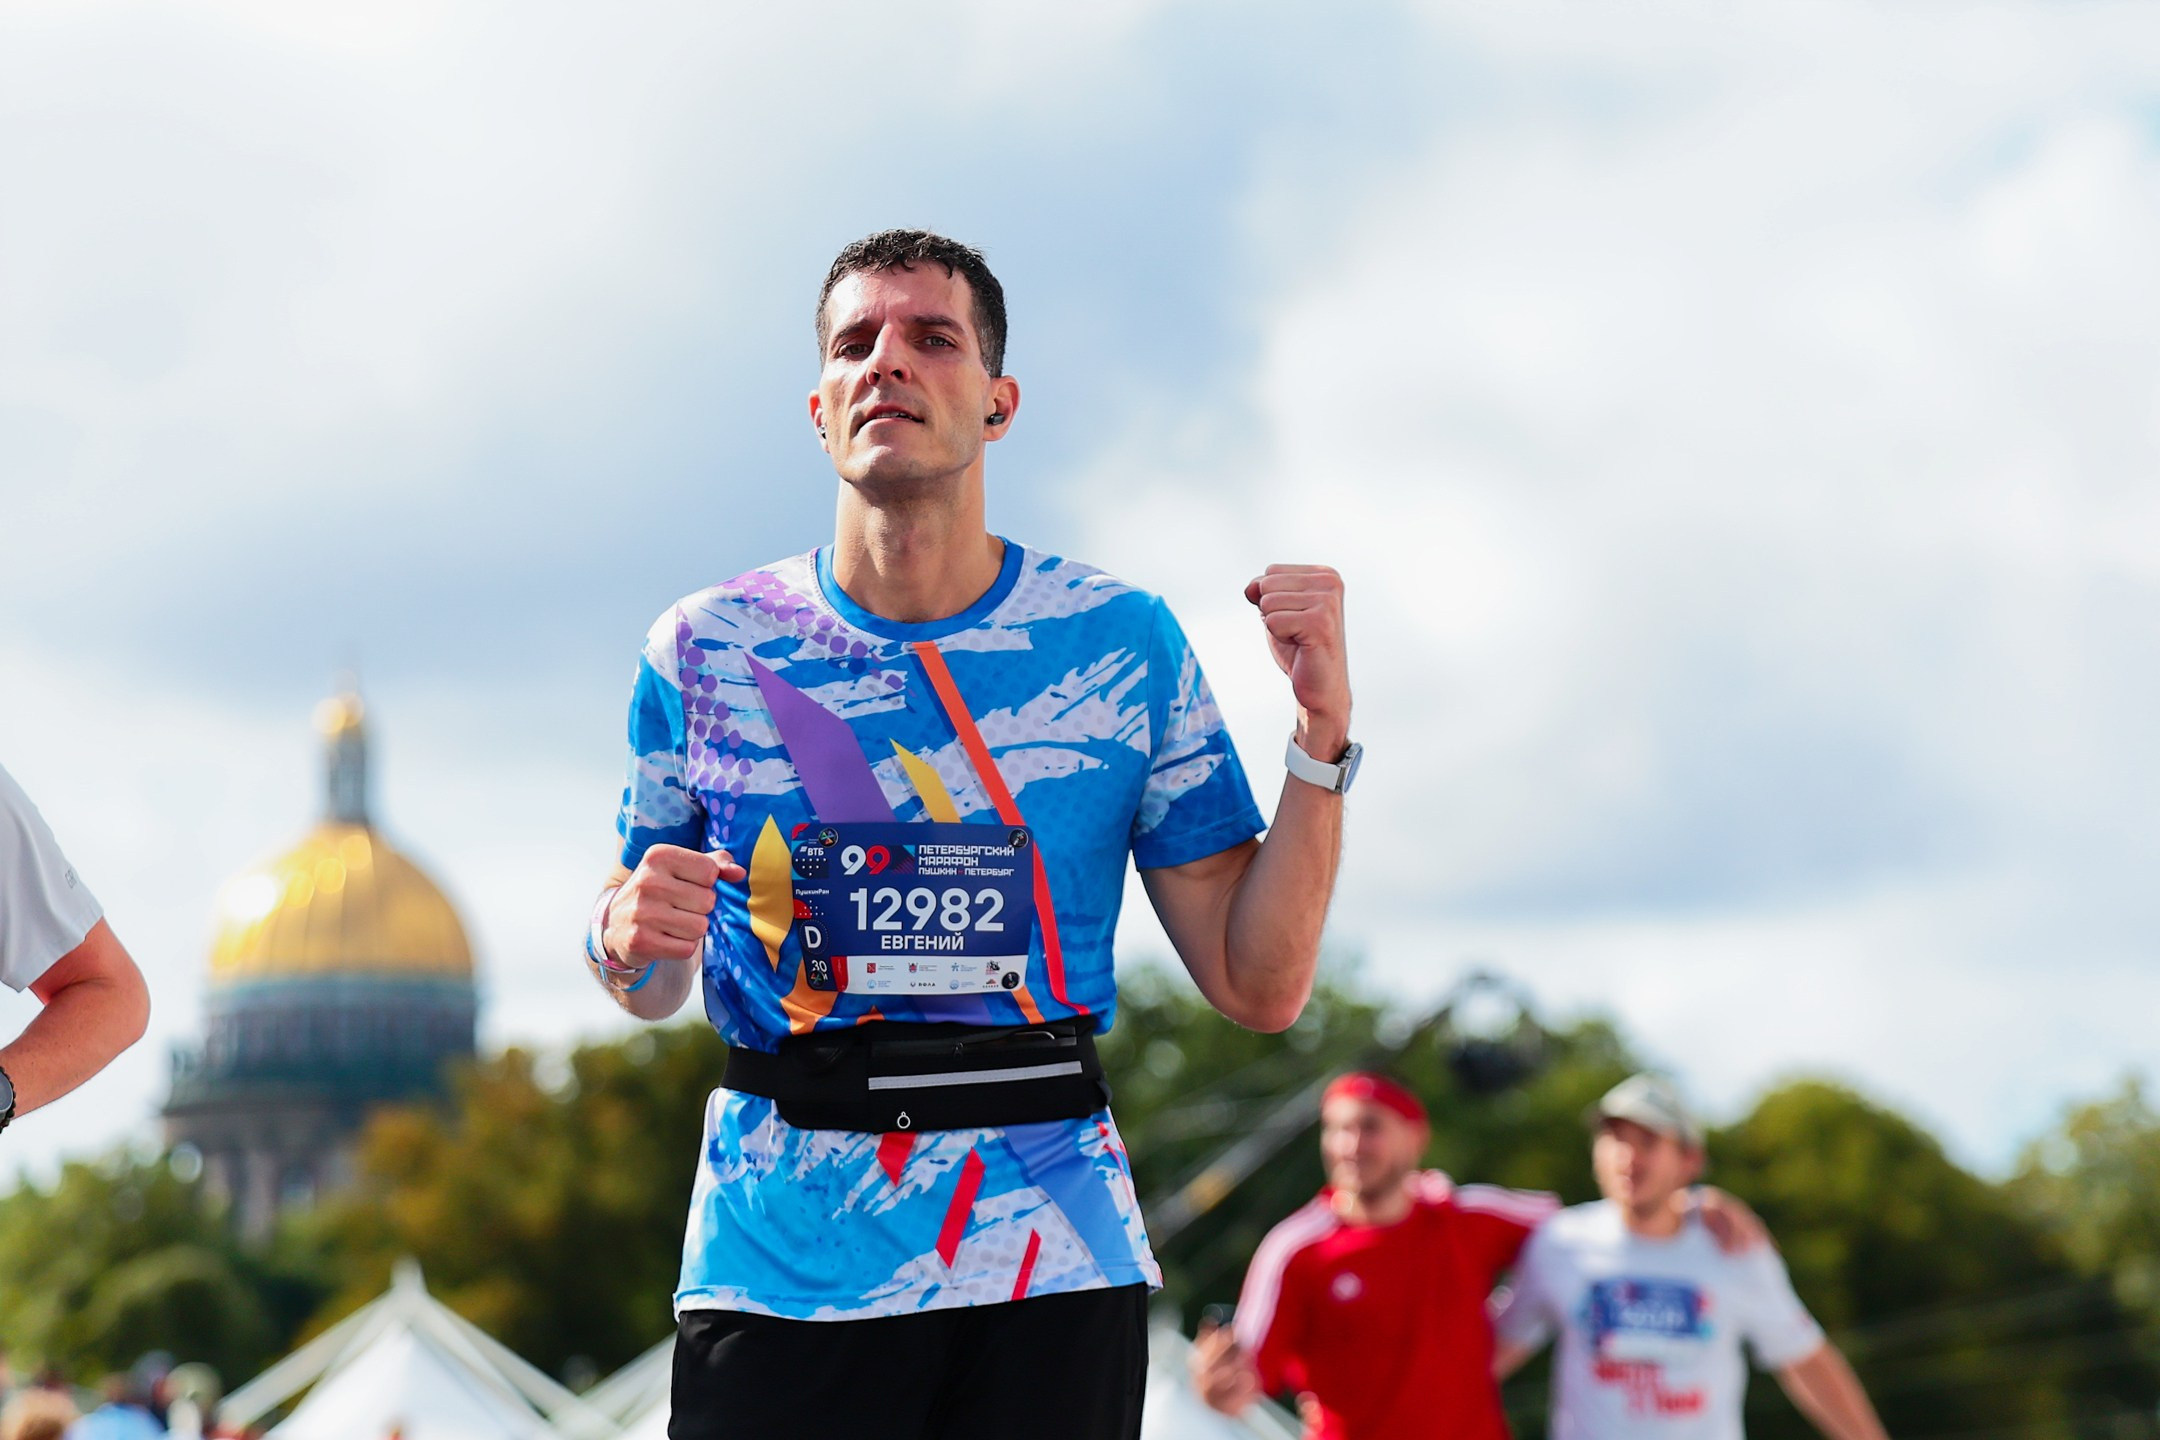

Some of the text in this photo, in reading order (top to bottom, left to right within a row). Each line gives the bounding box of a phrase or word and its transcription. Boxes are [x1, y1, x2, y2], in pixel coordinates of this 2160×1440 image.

[807, 847, 824, 856] ВТБ
[919, 845, 1015, 856] ПЕТЕРБУРГСКИЙ
[841, 845, 890, 875] 99
[919, 856, 979, 866] МАРАФОН
[919, 867, 1015, 876] ПУШКИН ПЕТЕРБУРГ
[795, 888, 830, 896] ПушкинРан
[850, 887, 1004, 932] 12982
[804, 926, 822, 949] D
[881, 932, 964, 950] ЕВГЕНИЙ
[811, 959, 828, 973] 30
